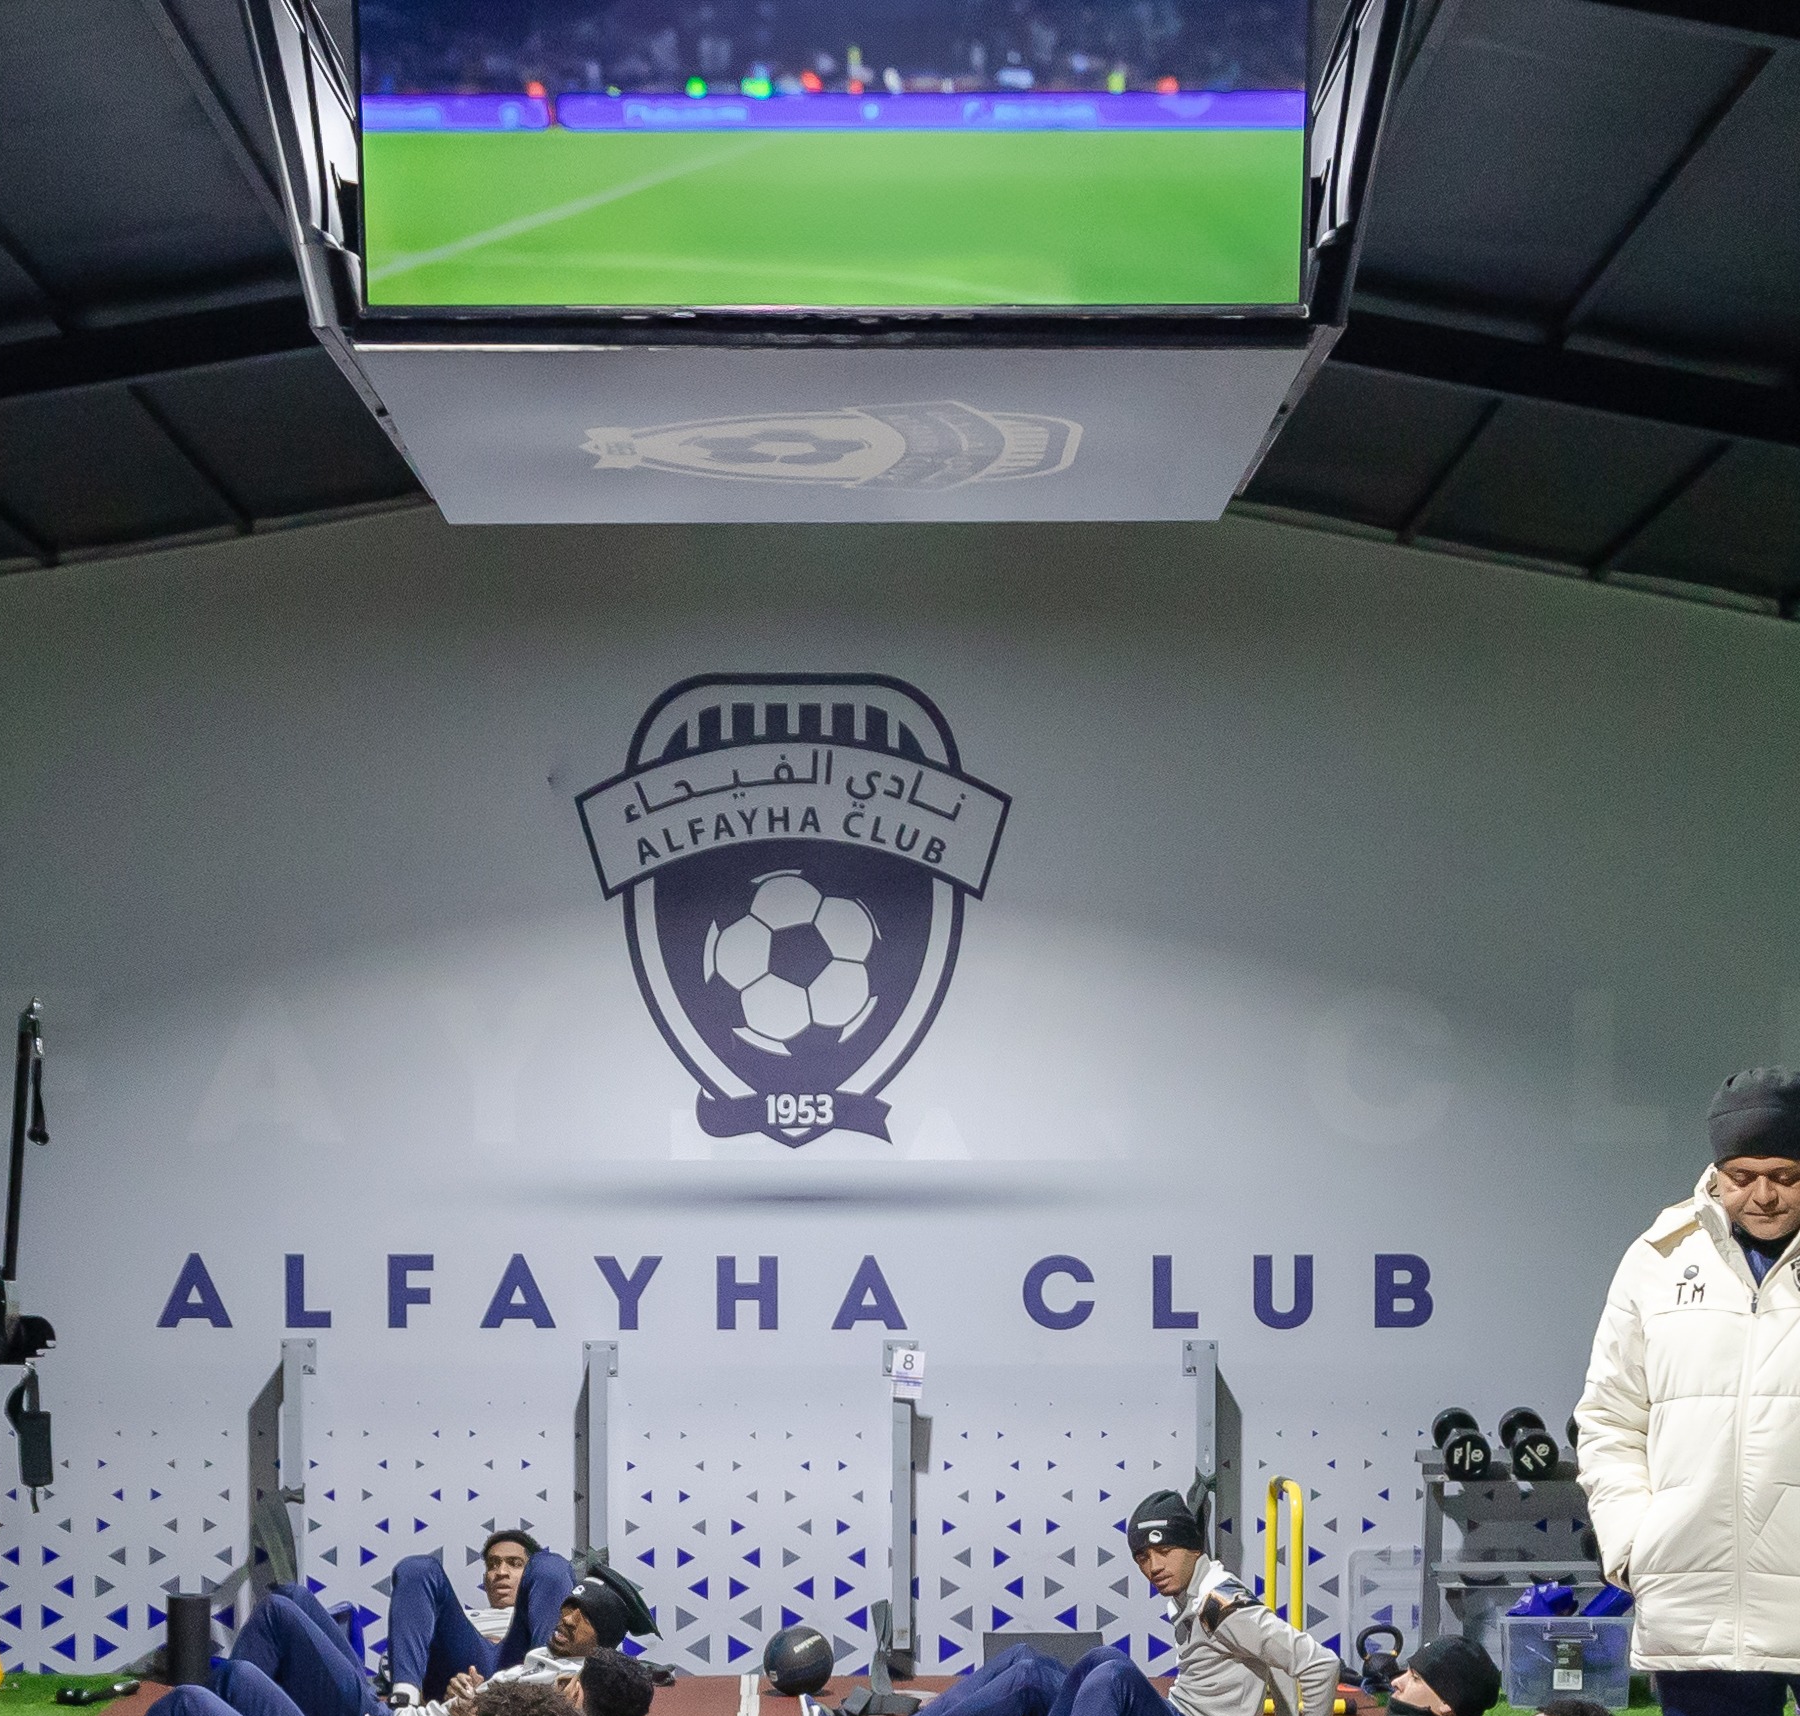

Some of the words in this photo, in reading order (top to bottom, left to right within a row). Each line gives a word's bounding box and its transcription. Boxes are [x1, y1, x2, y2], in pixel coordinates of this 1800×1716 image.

[635, 804, 822, 866] ALFAYHA
[843, 809, 947, 866] CLUB
[765, 1093, 835, 1126] 1953
[157, 1252, 908, 1331] ALFAYHA
[1022, 1253, 1434, 1331] CLUB
[902, 1353, 914, 1371] 8
